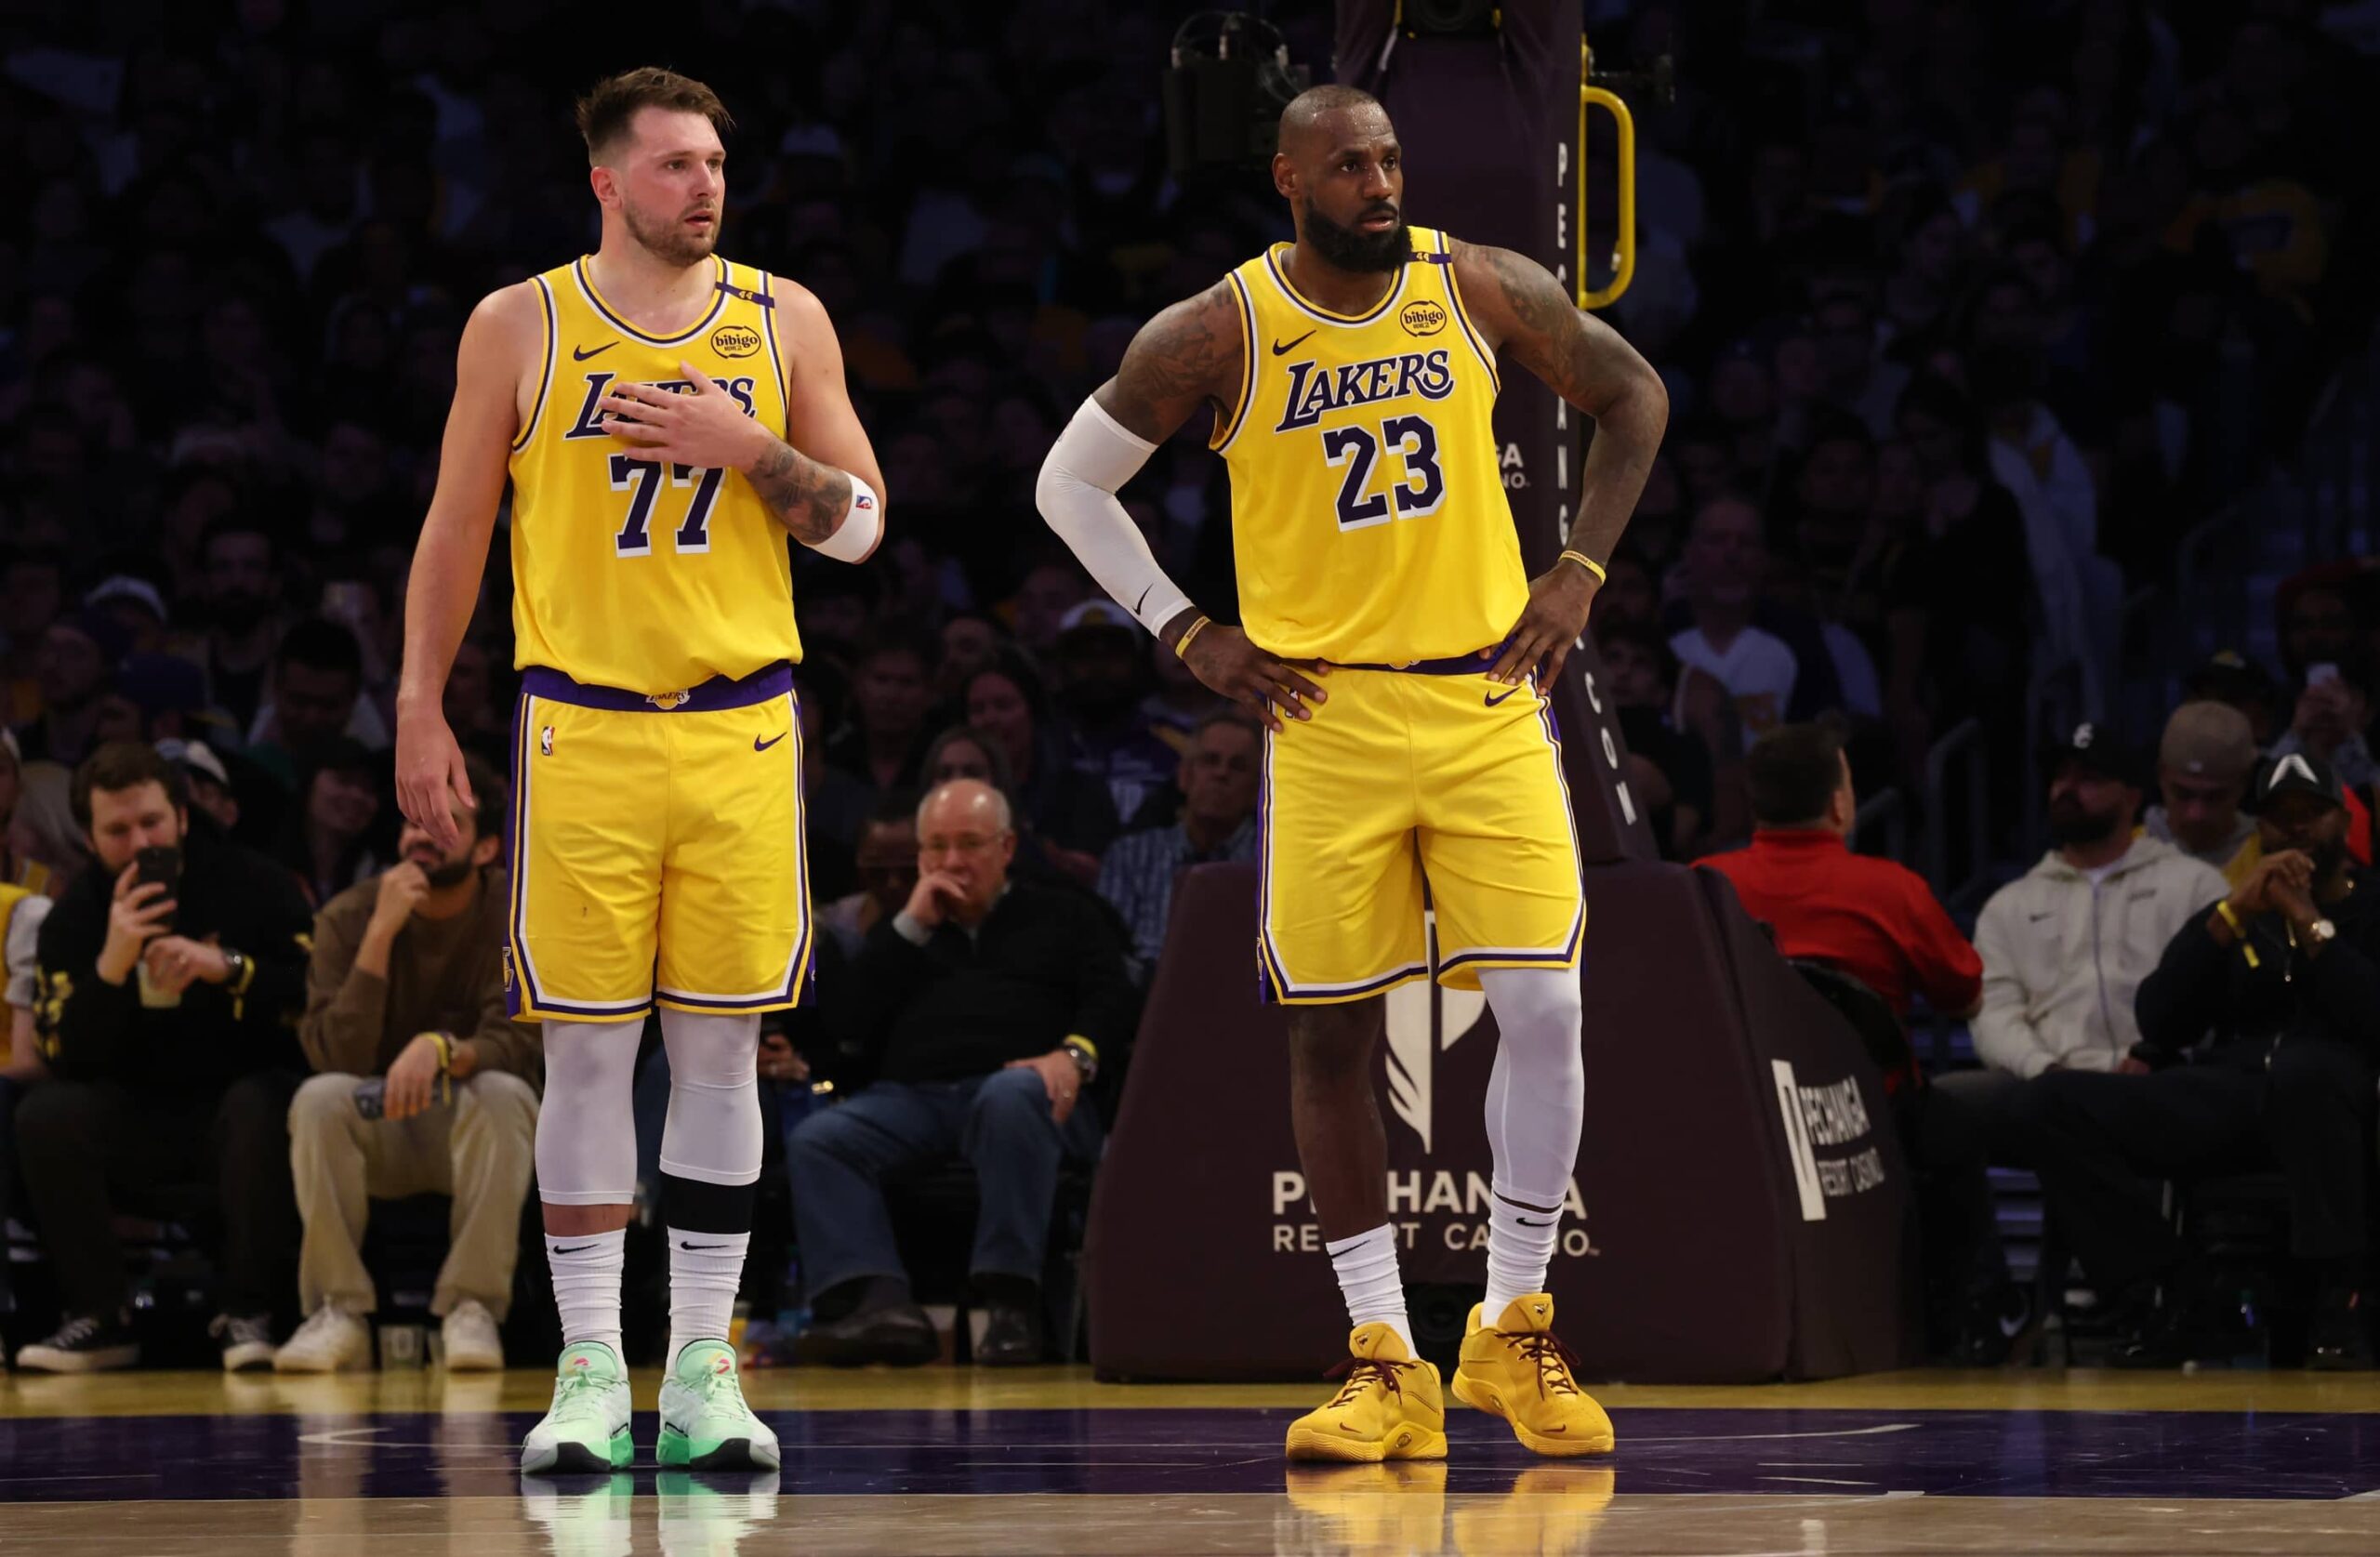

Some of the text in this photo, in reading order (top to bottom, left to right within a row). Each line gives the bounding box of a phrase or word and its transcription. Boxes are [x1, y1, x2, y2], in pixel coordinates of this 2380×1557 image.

[715, 334, 758, 349] bibigo
[1404, 310, 1444, 325] bibigo
[1274, 350, 1455, 434] LAKERS
[608, 453, 726, 558] 77
[1321, 415, 1447, 533] 23
